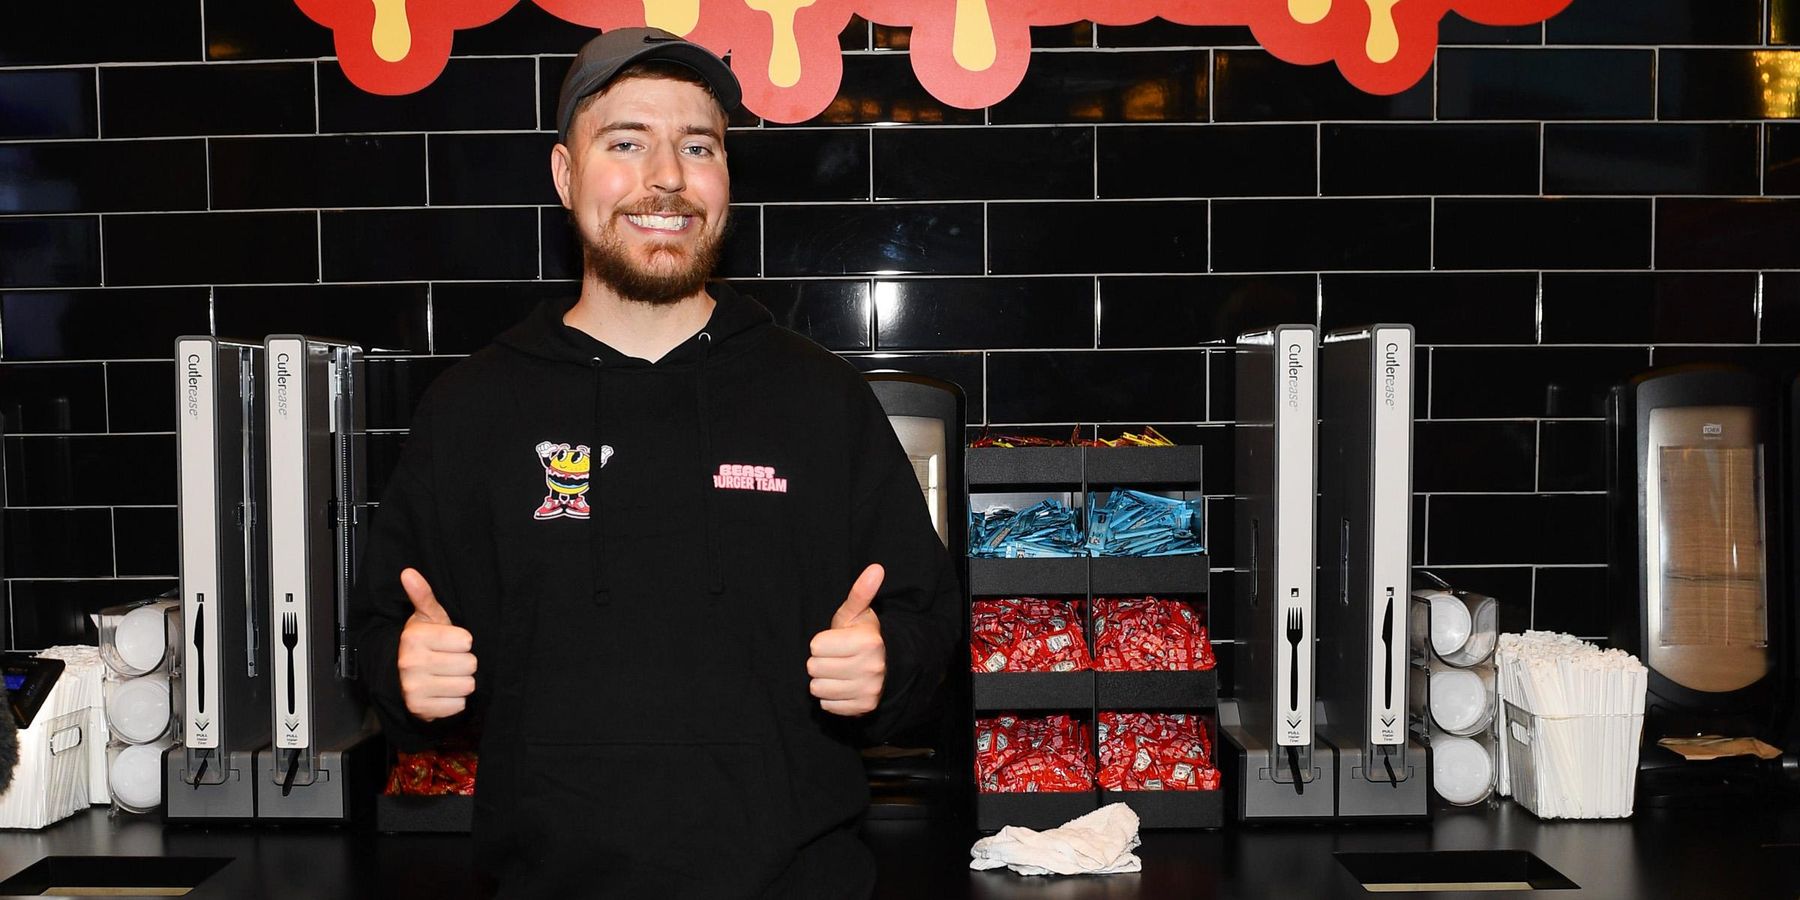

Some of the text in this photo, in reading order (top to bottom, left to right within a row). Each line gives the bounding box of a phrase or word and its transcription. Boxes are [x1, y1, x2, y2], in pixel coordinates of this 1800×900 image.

[188, 354, 202, 416] Cutlerease
[277, 353, 292, 416] Cutlerease
[1288, 343, 1303, 408] Cutlerease
[1385, 342, 1400, 407] Cutlerease
[720, 464, 775, 479] BEAST
[755, 477, 787, 493] TEAM
